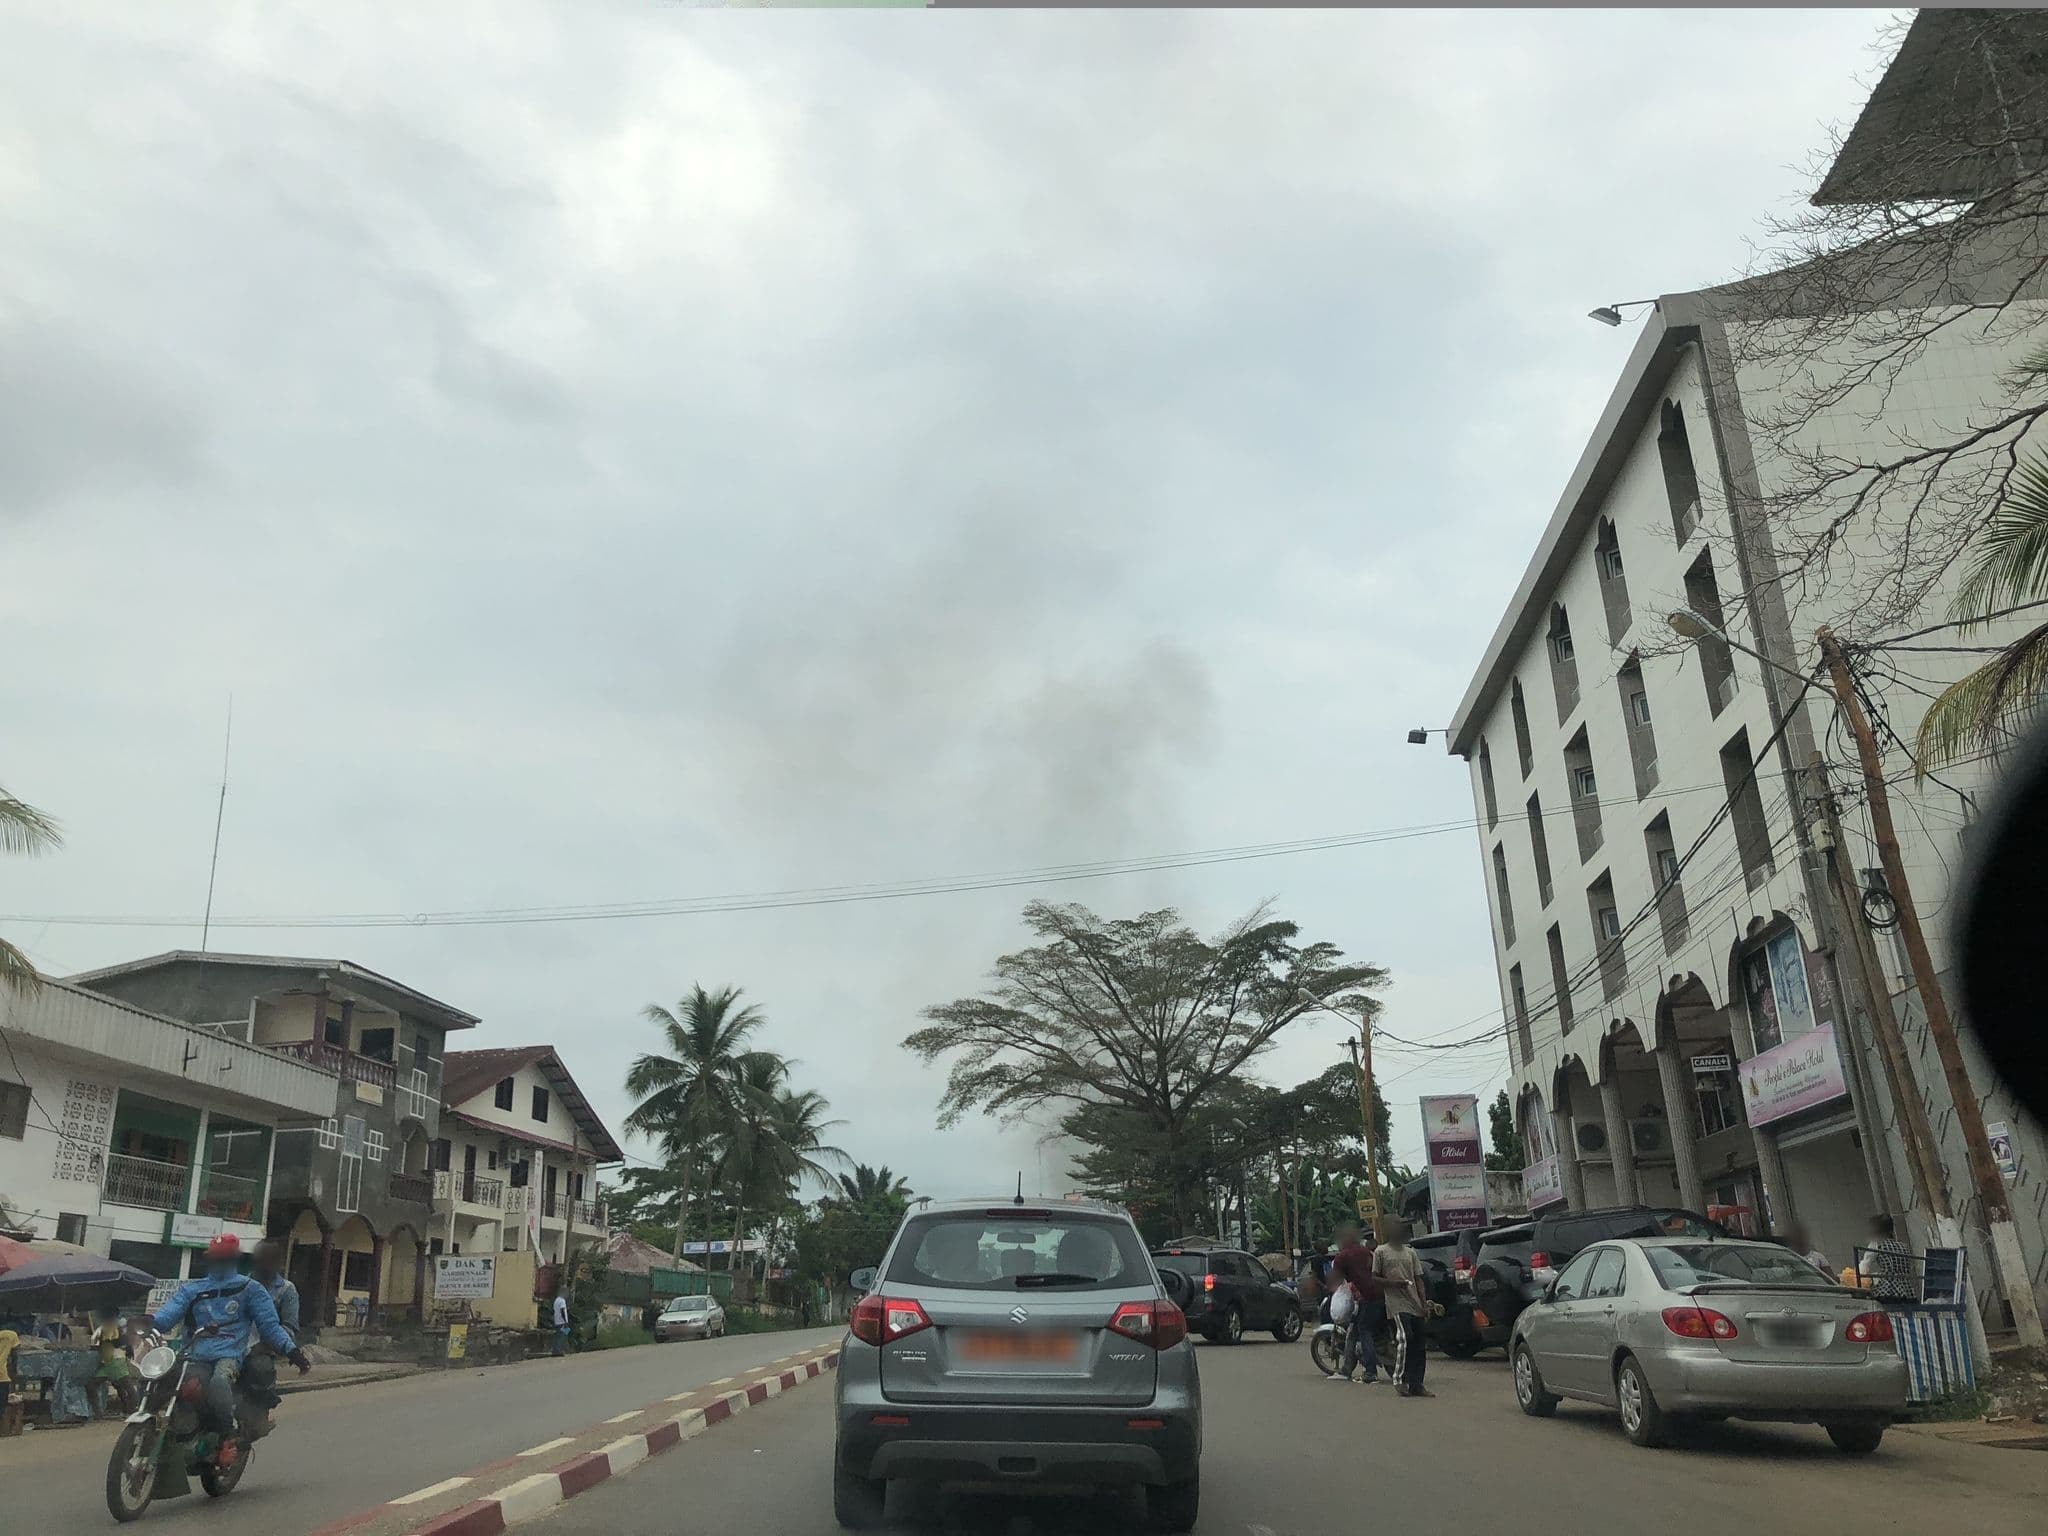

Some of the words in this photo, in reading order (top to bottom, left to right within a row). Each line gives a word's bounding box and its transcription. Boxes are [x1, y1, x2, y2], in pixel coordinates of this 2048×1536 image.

[1694, 1057, 1727, 1066] CANAL+
[455, 1259, 475, 1268] DAK
[1108, 1353, 1146, 1361] VITARA
